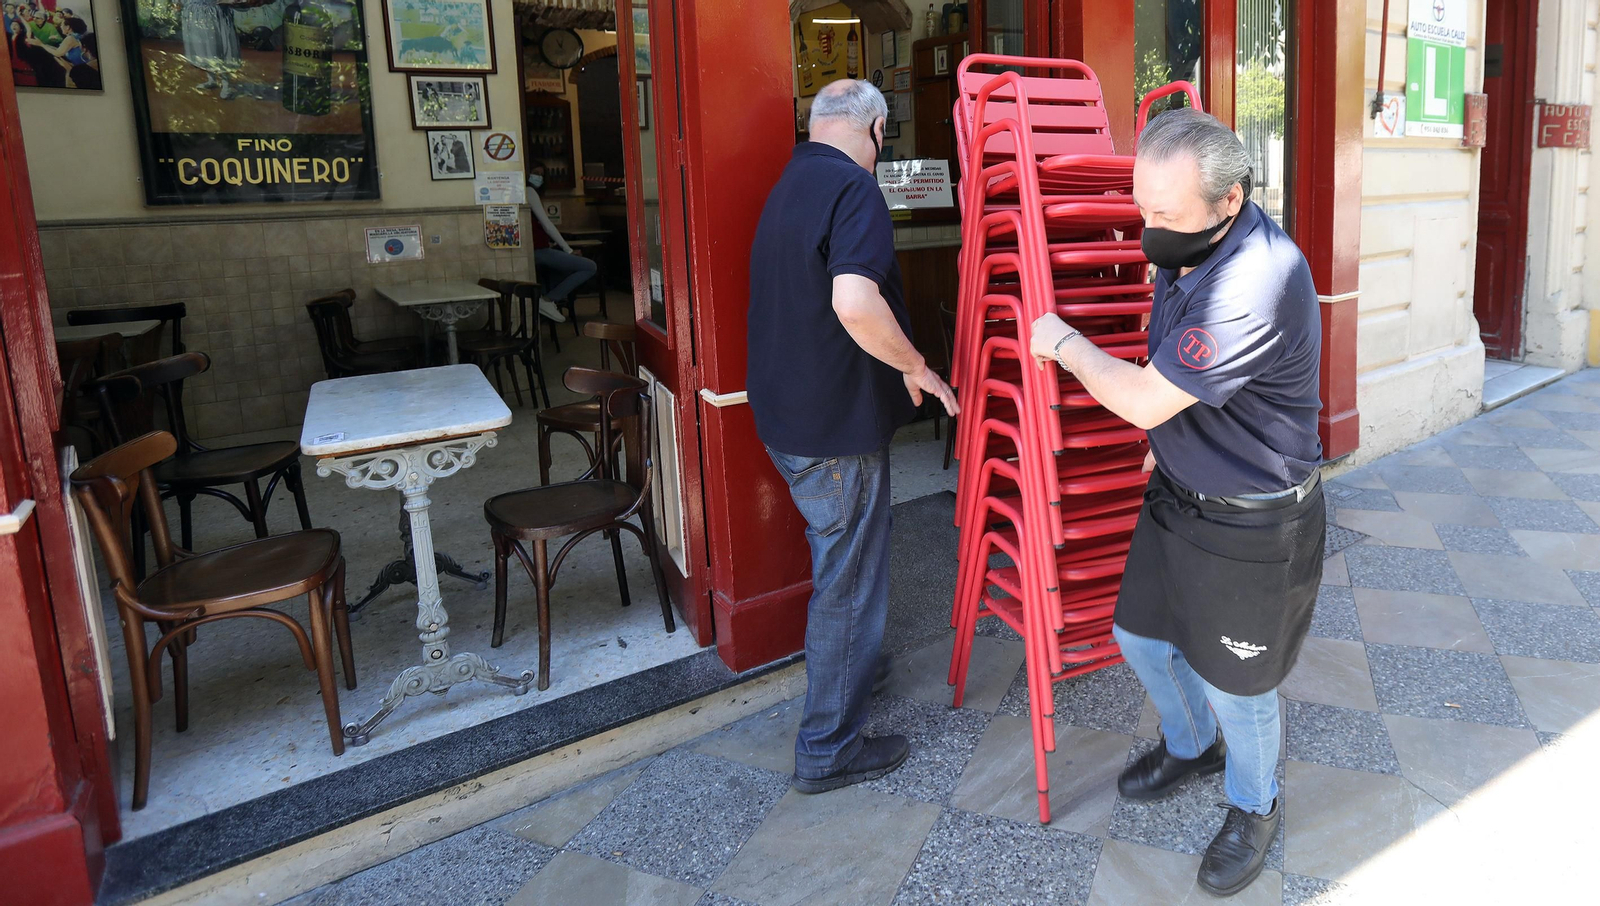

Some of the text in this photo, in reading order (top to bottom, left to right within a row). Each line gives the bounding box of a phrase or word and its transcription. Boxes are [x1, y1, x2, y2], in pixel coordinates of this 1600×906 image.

[1411, 21, 1426, 33] AUTO
[1428, 24, 1450, 37] ESCUELA
[1424, 46, 1448, 117] L
[1544, 105, 1582, 117] AUTO
[1541, 124, 1561, 145] F
[237, 138, 293, 152] FINO
[1183, 334, 1212, 362] TP
